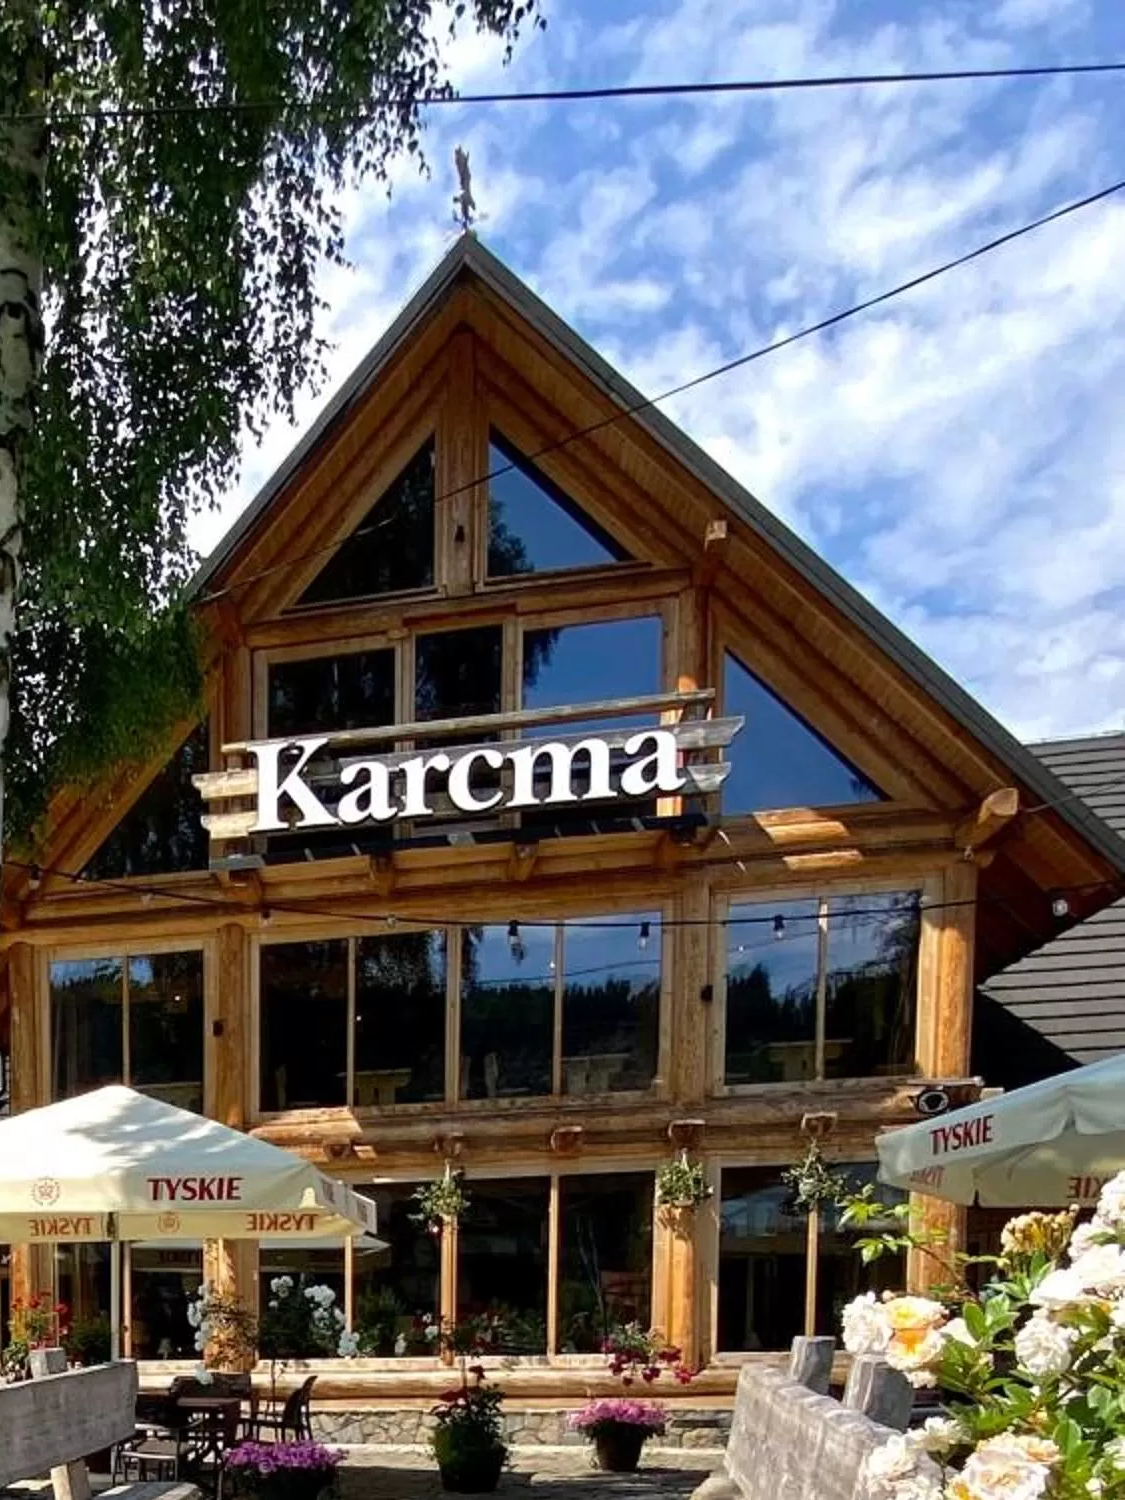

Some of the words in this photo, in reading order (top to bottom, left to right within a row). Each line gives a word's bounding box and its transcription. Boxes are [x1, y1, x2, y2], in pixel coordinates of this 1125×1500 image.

[249, 729, 686, 832] Karcma
[930, 1114, 994, 1155] TYSKIE
[147, 1177, 244, 1200] TYSKIE
